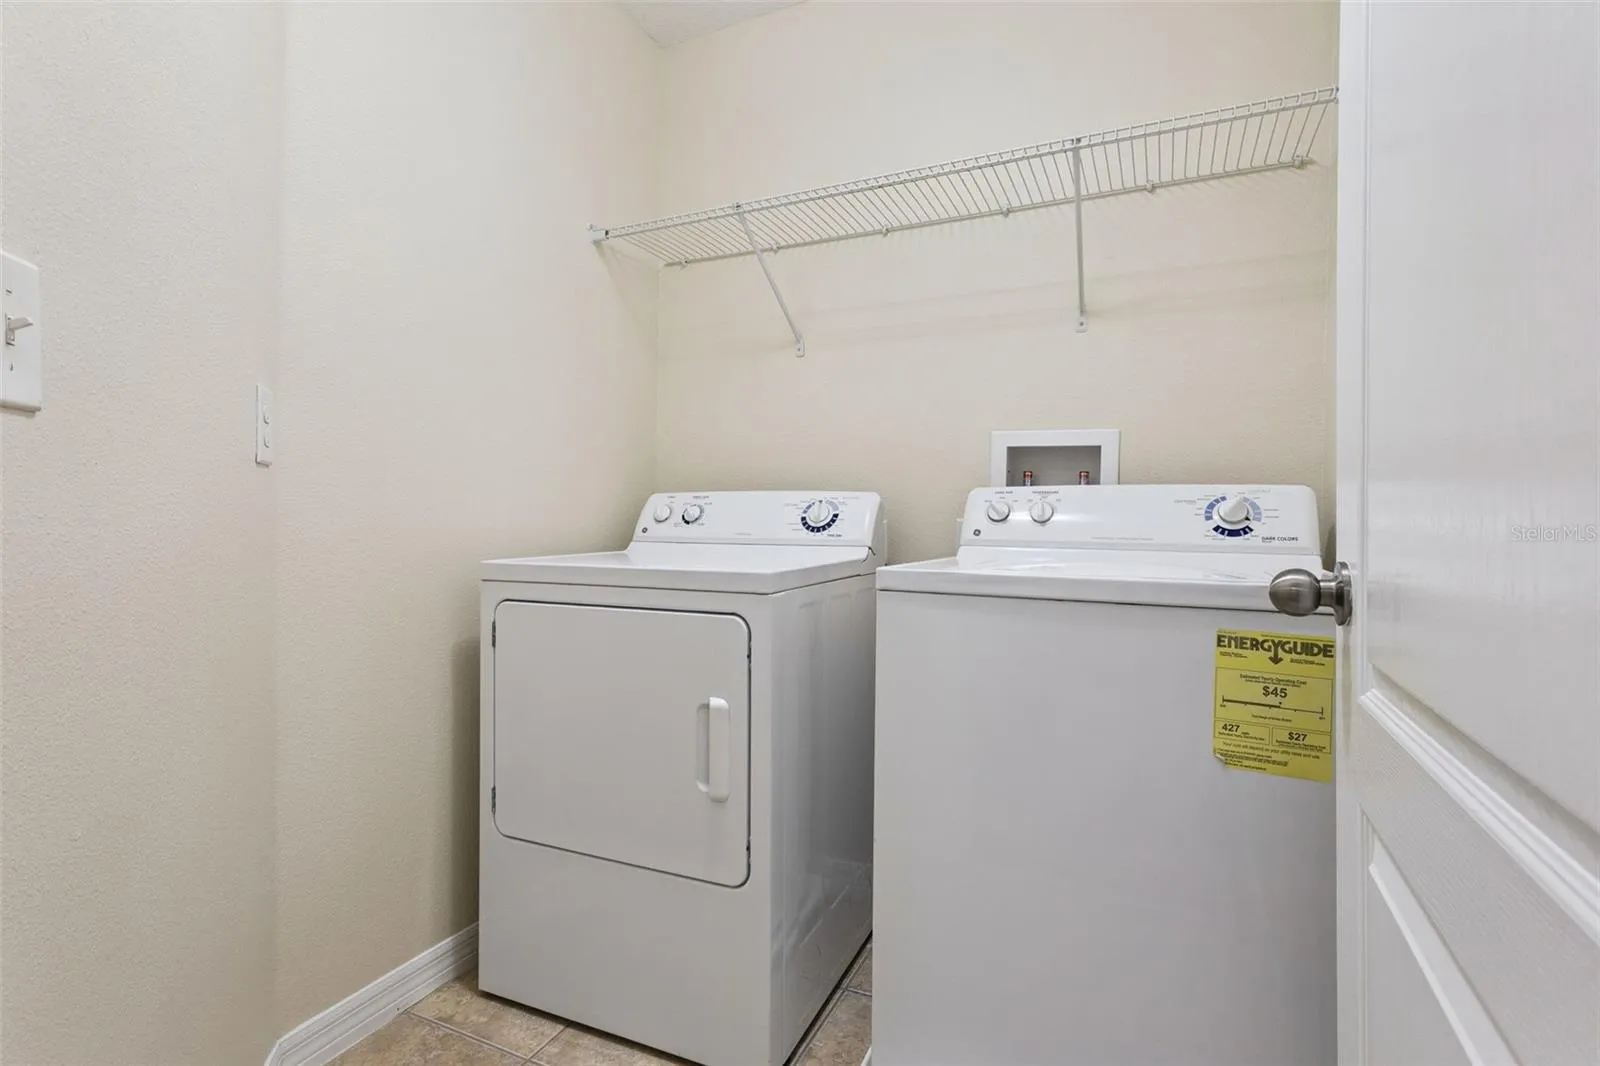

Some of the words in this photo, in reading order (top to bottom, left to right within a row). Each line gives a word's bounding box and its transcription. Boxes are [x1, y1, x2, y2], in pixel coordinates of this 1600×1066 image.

[1216, 634, 1334, 662] ENERGYGUIDE
[1262, 685, 1288, 698] $45
[1222, 723, 1240, 733] 427
[1288, 731, 1308, 742] $27
